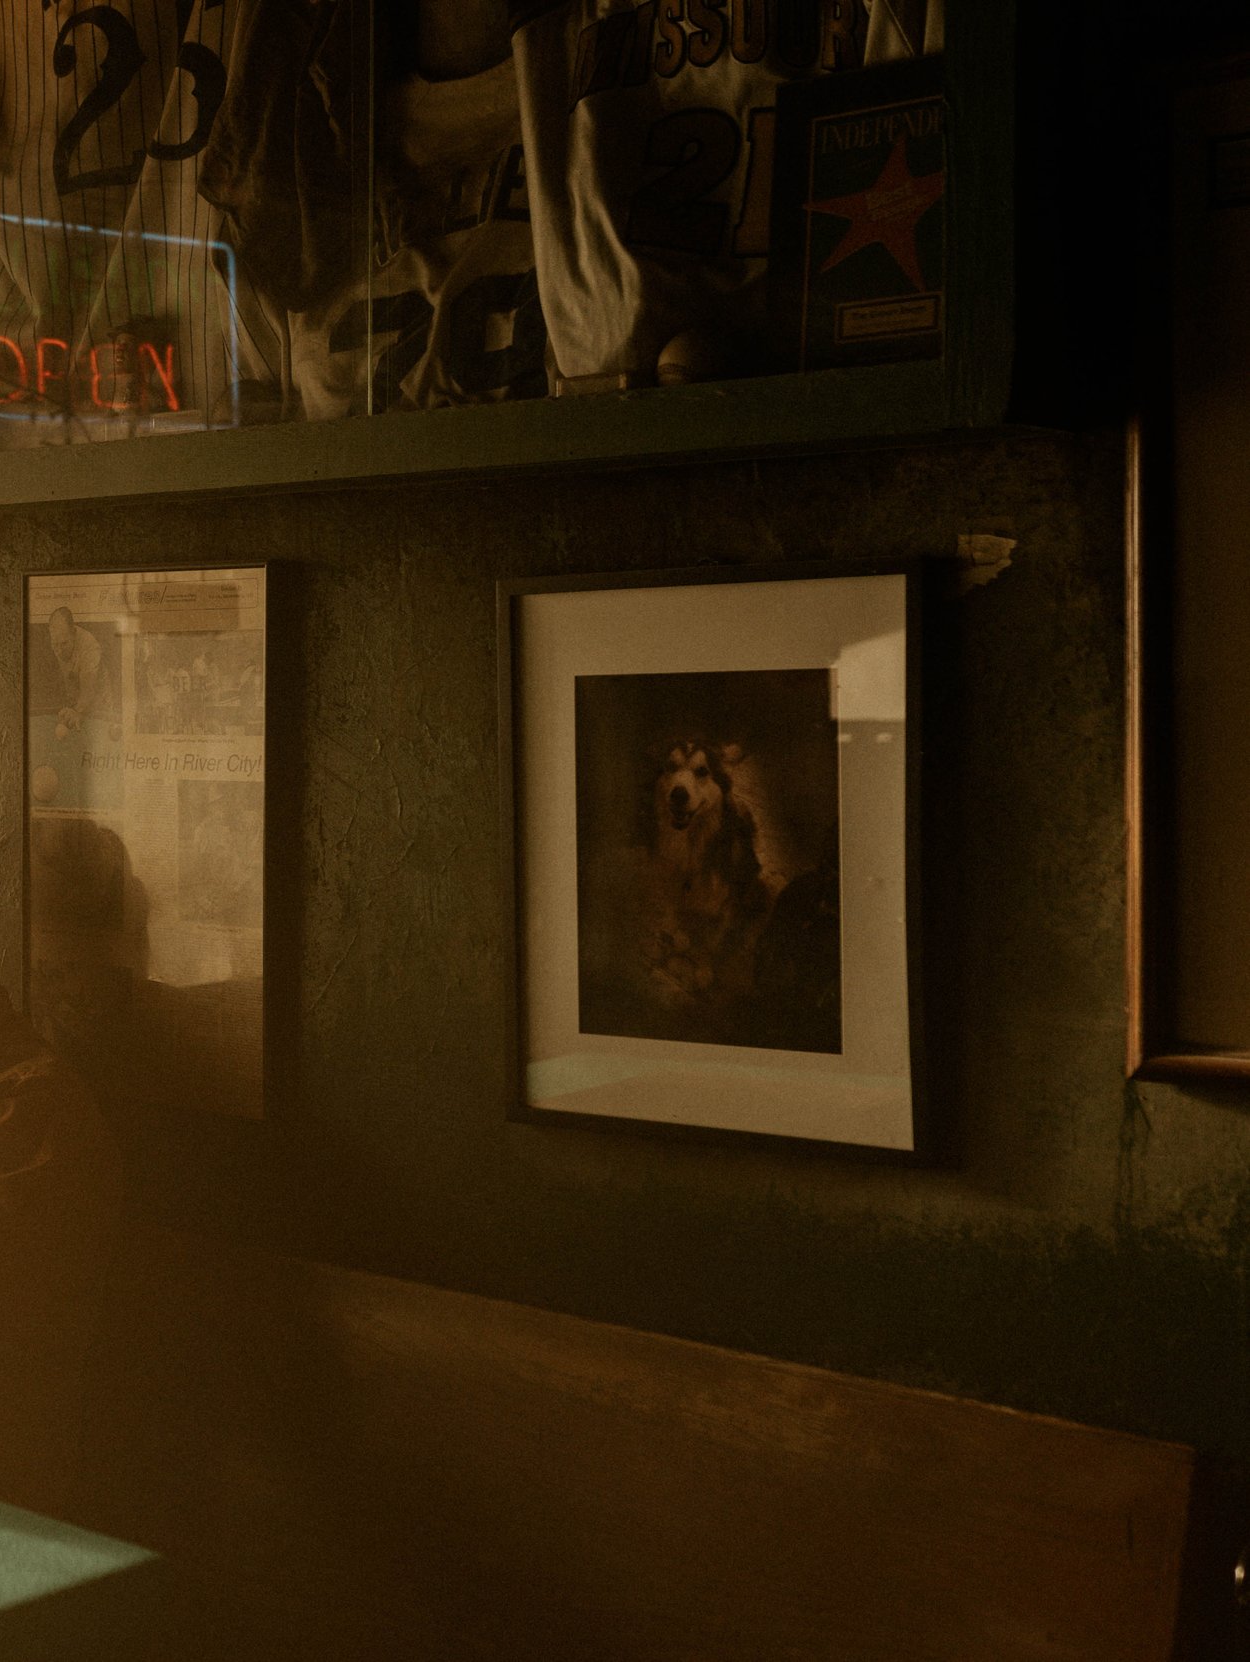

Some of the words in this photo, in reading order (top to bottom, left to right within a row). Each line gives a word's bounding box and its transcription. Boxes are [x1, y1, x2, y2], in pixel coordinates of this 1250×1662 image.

[80, 751, 121, 773] Right
[124, 752, 160, 770] Here
[164, 753, 178, 770] In
[182, 753, 223, 771] River
[227, 754, 263, 777] City!
